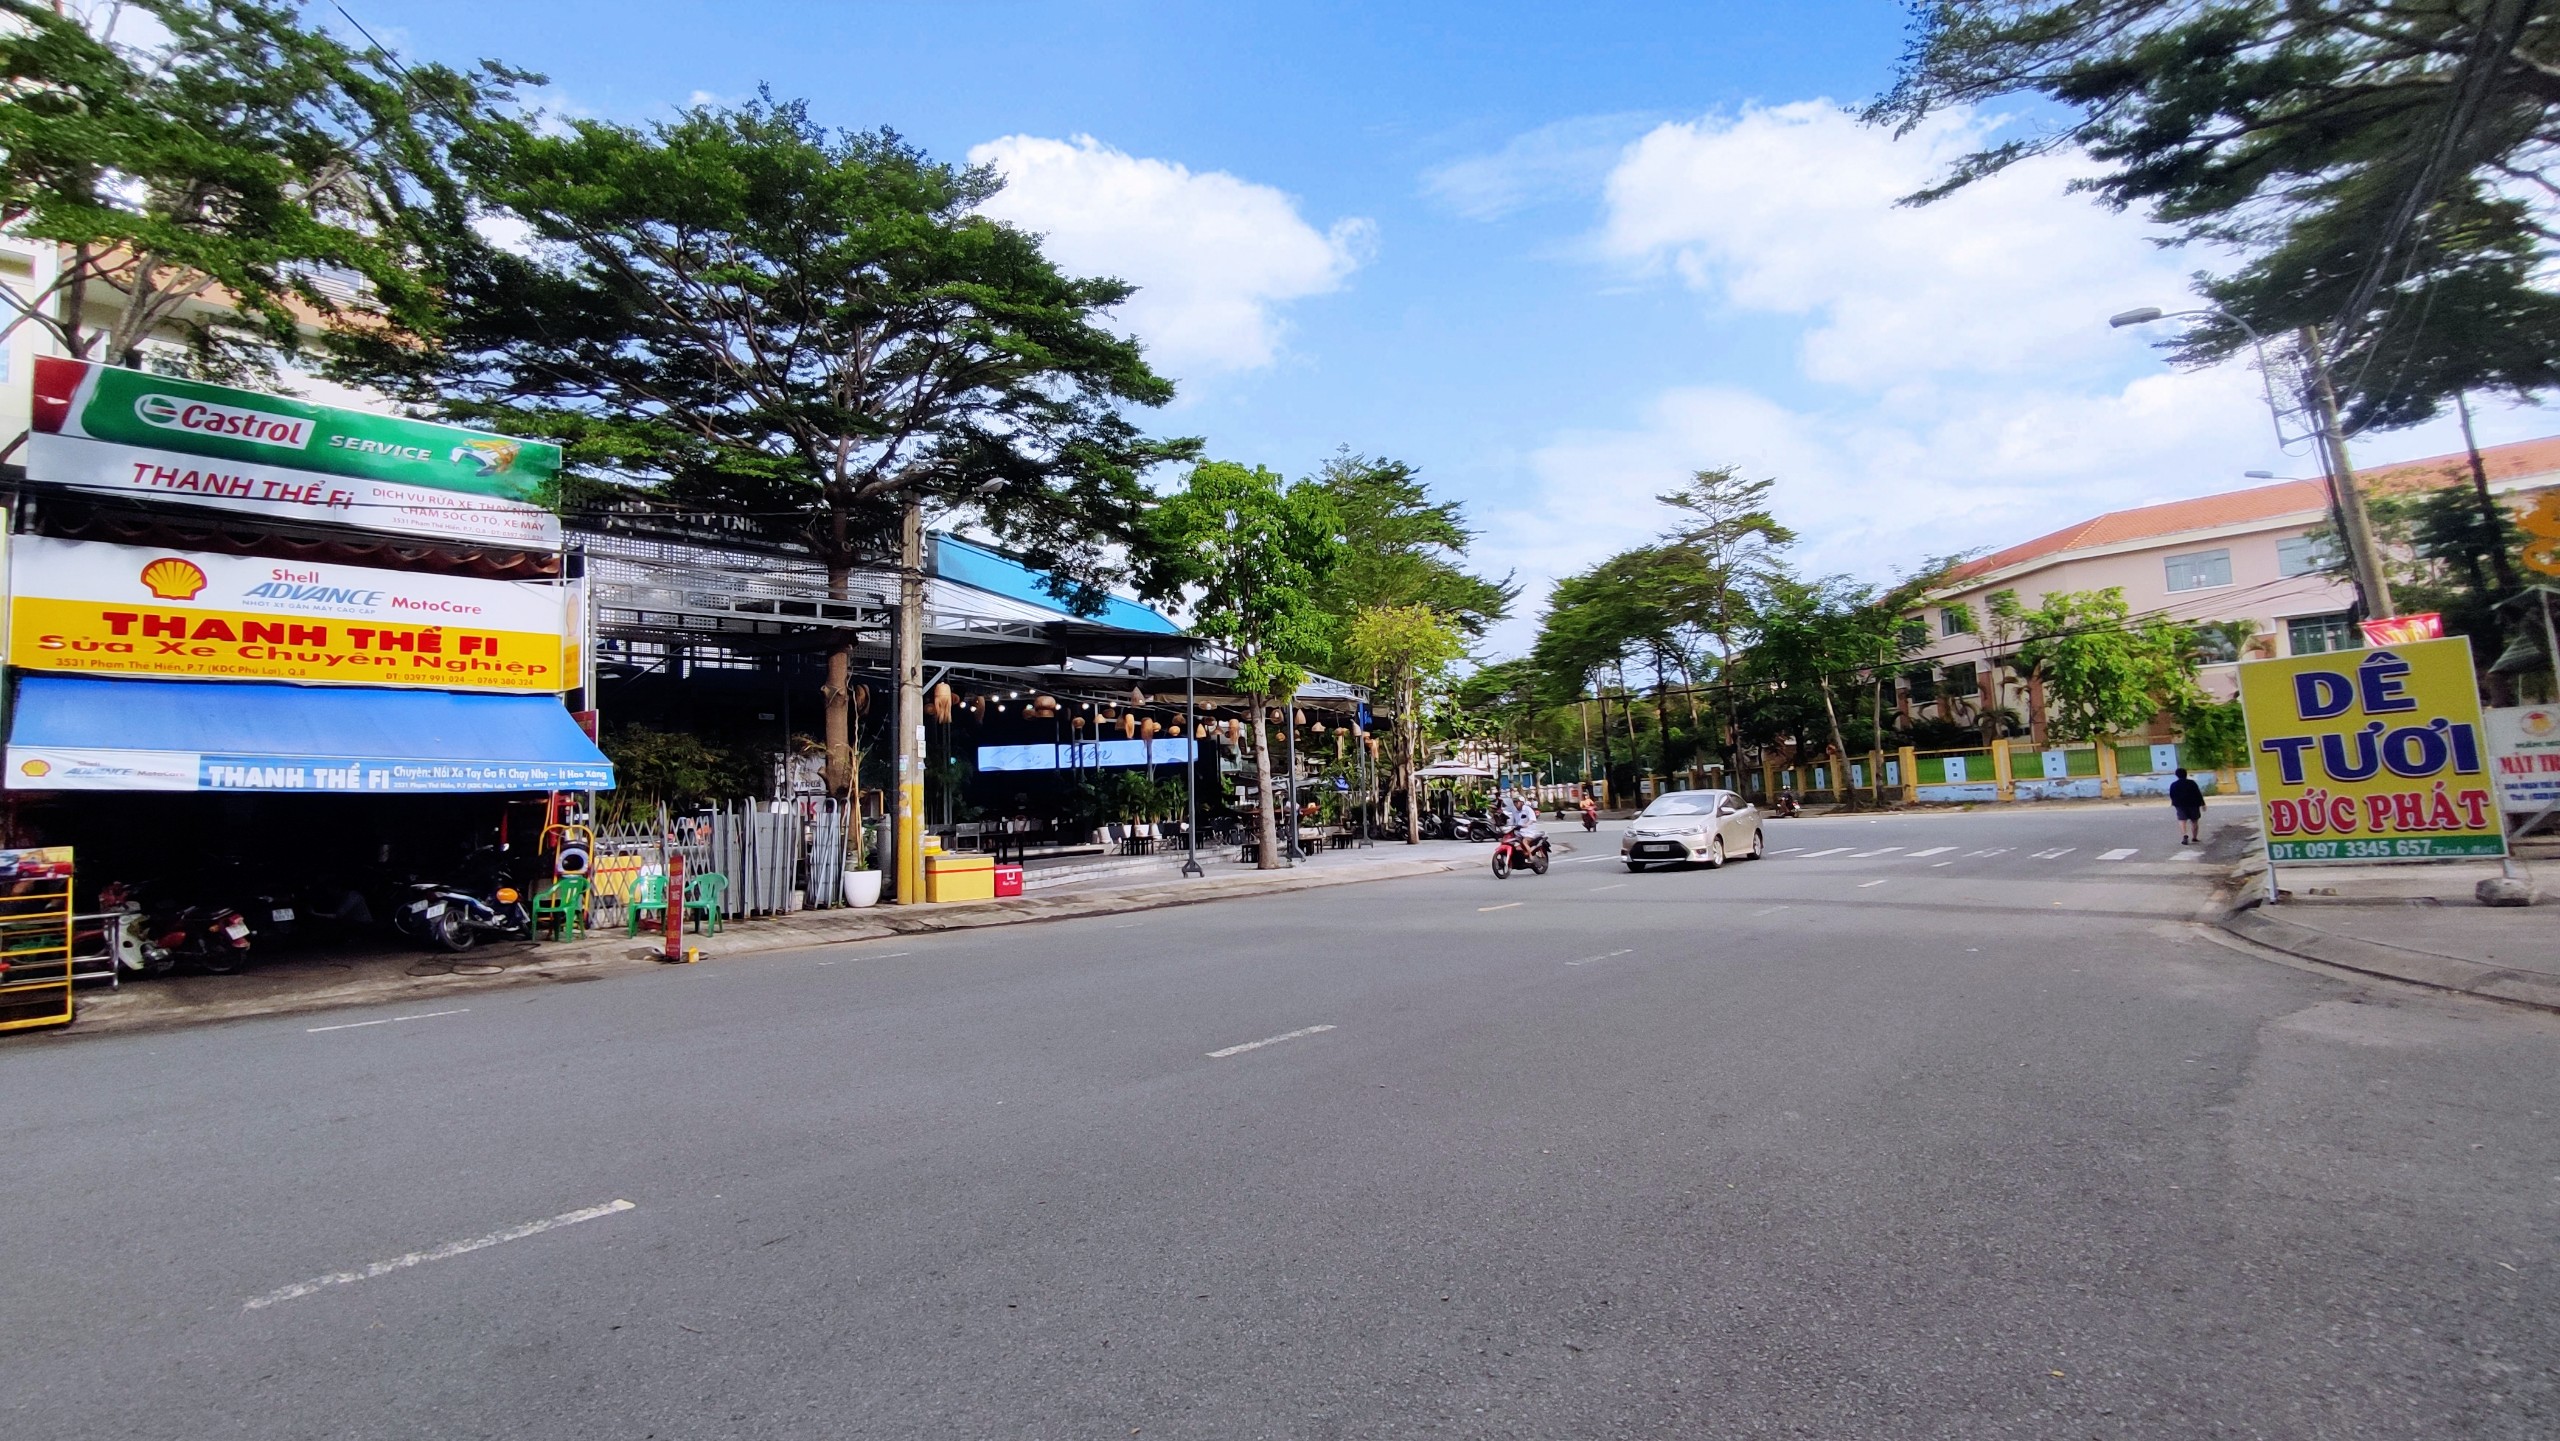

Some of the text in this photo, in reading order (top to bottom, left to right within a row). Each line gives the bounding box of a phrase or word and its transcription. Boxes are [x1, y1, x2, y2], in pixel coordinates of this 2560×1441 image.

[181, 404, 302, 444] Castrol
[329, 435, 432, 462] SERVICE
[133, 463, 254, 498] THANH
[262, 480, 326, 505] THỂ
[373, 488, 404, 500] DỊCH
[407, 493, 425, 505] VỤ
[428, 495, 455, 507] RỬA
[504, 518, 518, 528] XE
[521, 519, 545, 531] MÁY
[272, 568, 319, 584] Shell
[242, 582, 385, 606] ADVANCE
[391, 597, 482, 615] MotoCare
[102, 611, 498, 657] THANH THỂ FI
[37, 634, 134, 653] Sửa
[153, 641, 217, 656] Xe
[237, 645, 396, 667] Chuyên
[413, 655, 548, 676] Nghiệp
[56, 658, 84, 667] 3531
[187, 663, 204, 671] P.7
[208, 664, 236, 674] (KDC
[239, 665, 258, 674] Phú
[288, 668, 306, 676] Q.8
[404, 673, 426, 681] 0397
[430, 674, 445, 682] 991
[449, 675, 465, 683] 024
[519, 678, 533, 686] 324
[2292, 651, 2417, 720] DÊ
[2260, 718, 2481, 785] TƯƠI
[208, 762, 390, 789] THANH THỂ FI
[452, 767, 464, 778] Xe
[465, 767, 481, 780] Tay
[483, 767, 497, 779] Ga
[499, 768, 507, 779] Fi
[508, 768, 529, 781] Chạy
[567, 770, 584, 778] Hao
[2269, 781, 2490, 835] ĐỨC PHÁT
[2272, 843, 2301, 859] ĐT:
[2305, 842, 2339, 858] 097
[2344, 840, 2391, 858] 3345
[2396, 839, 2432, 857] 657
